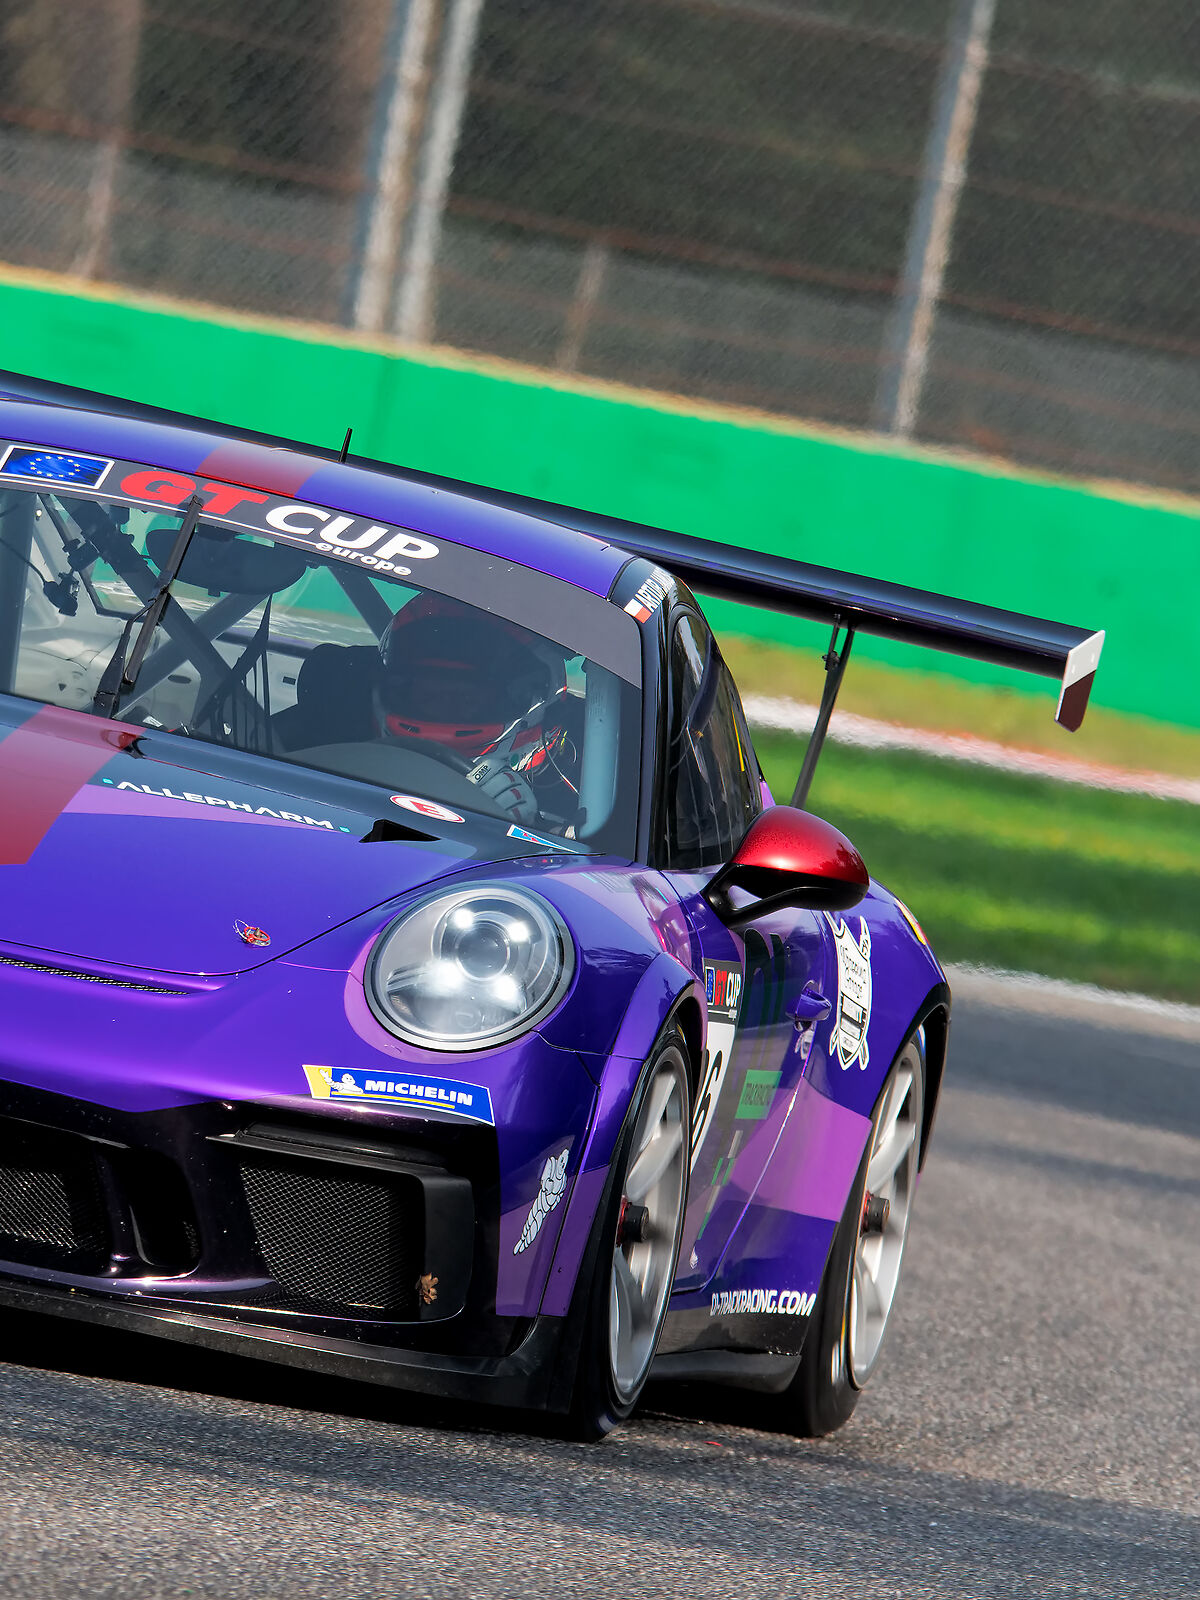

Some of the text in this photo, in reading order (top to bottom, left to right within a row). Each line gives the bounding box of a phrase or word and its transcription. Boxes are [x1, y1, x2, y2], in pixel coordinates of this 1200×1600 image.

[120, 470, 440, 561] GT CUP
[315, 541, 412, 577] europe
[473, 764, 491, 781] OMP
[116, 781, 334, 829] ALLEPHARM
[714, 969, 741, 1007] GT CUP
[364, 1079, 474, 1107] MICHELIN
